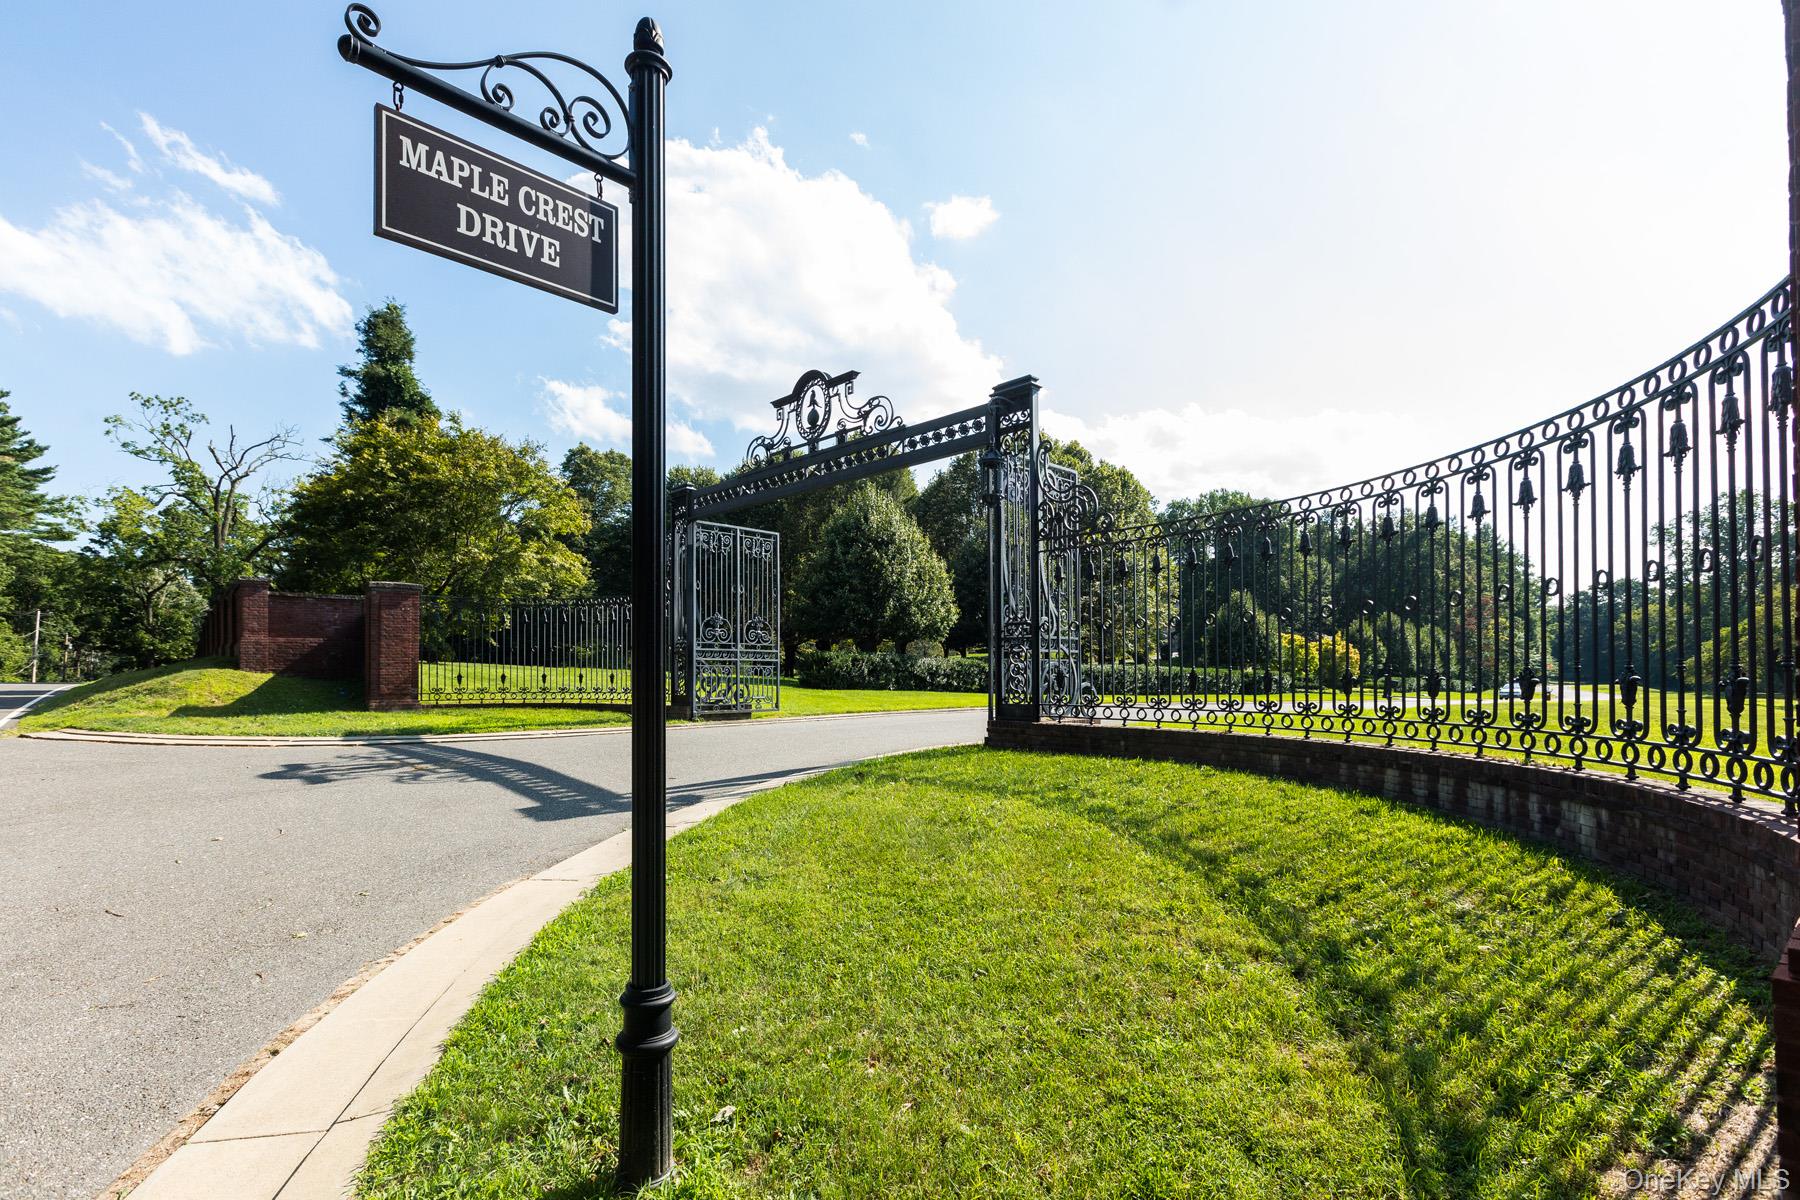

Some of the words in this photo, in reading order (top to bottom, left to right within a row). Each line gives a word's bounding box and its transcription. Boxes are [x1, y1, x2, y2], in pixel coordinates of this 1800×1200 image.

[399, 134, 509, 207] MAPLE
[518, 185, 605, 244] CREST
[456, 202, 560, 268] DRIVE
